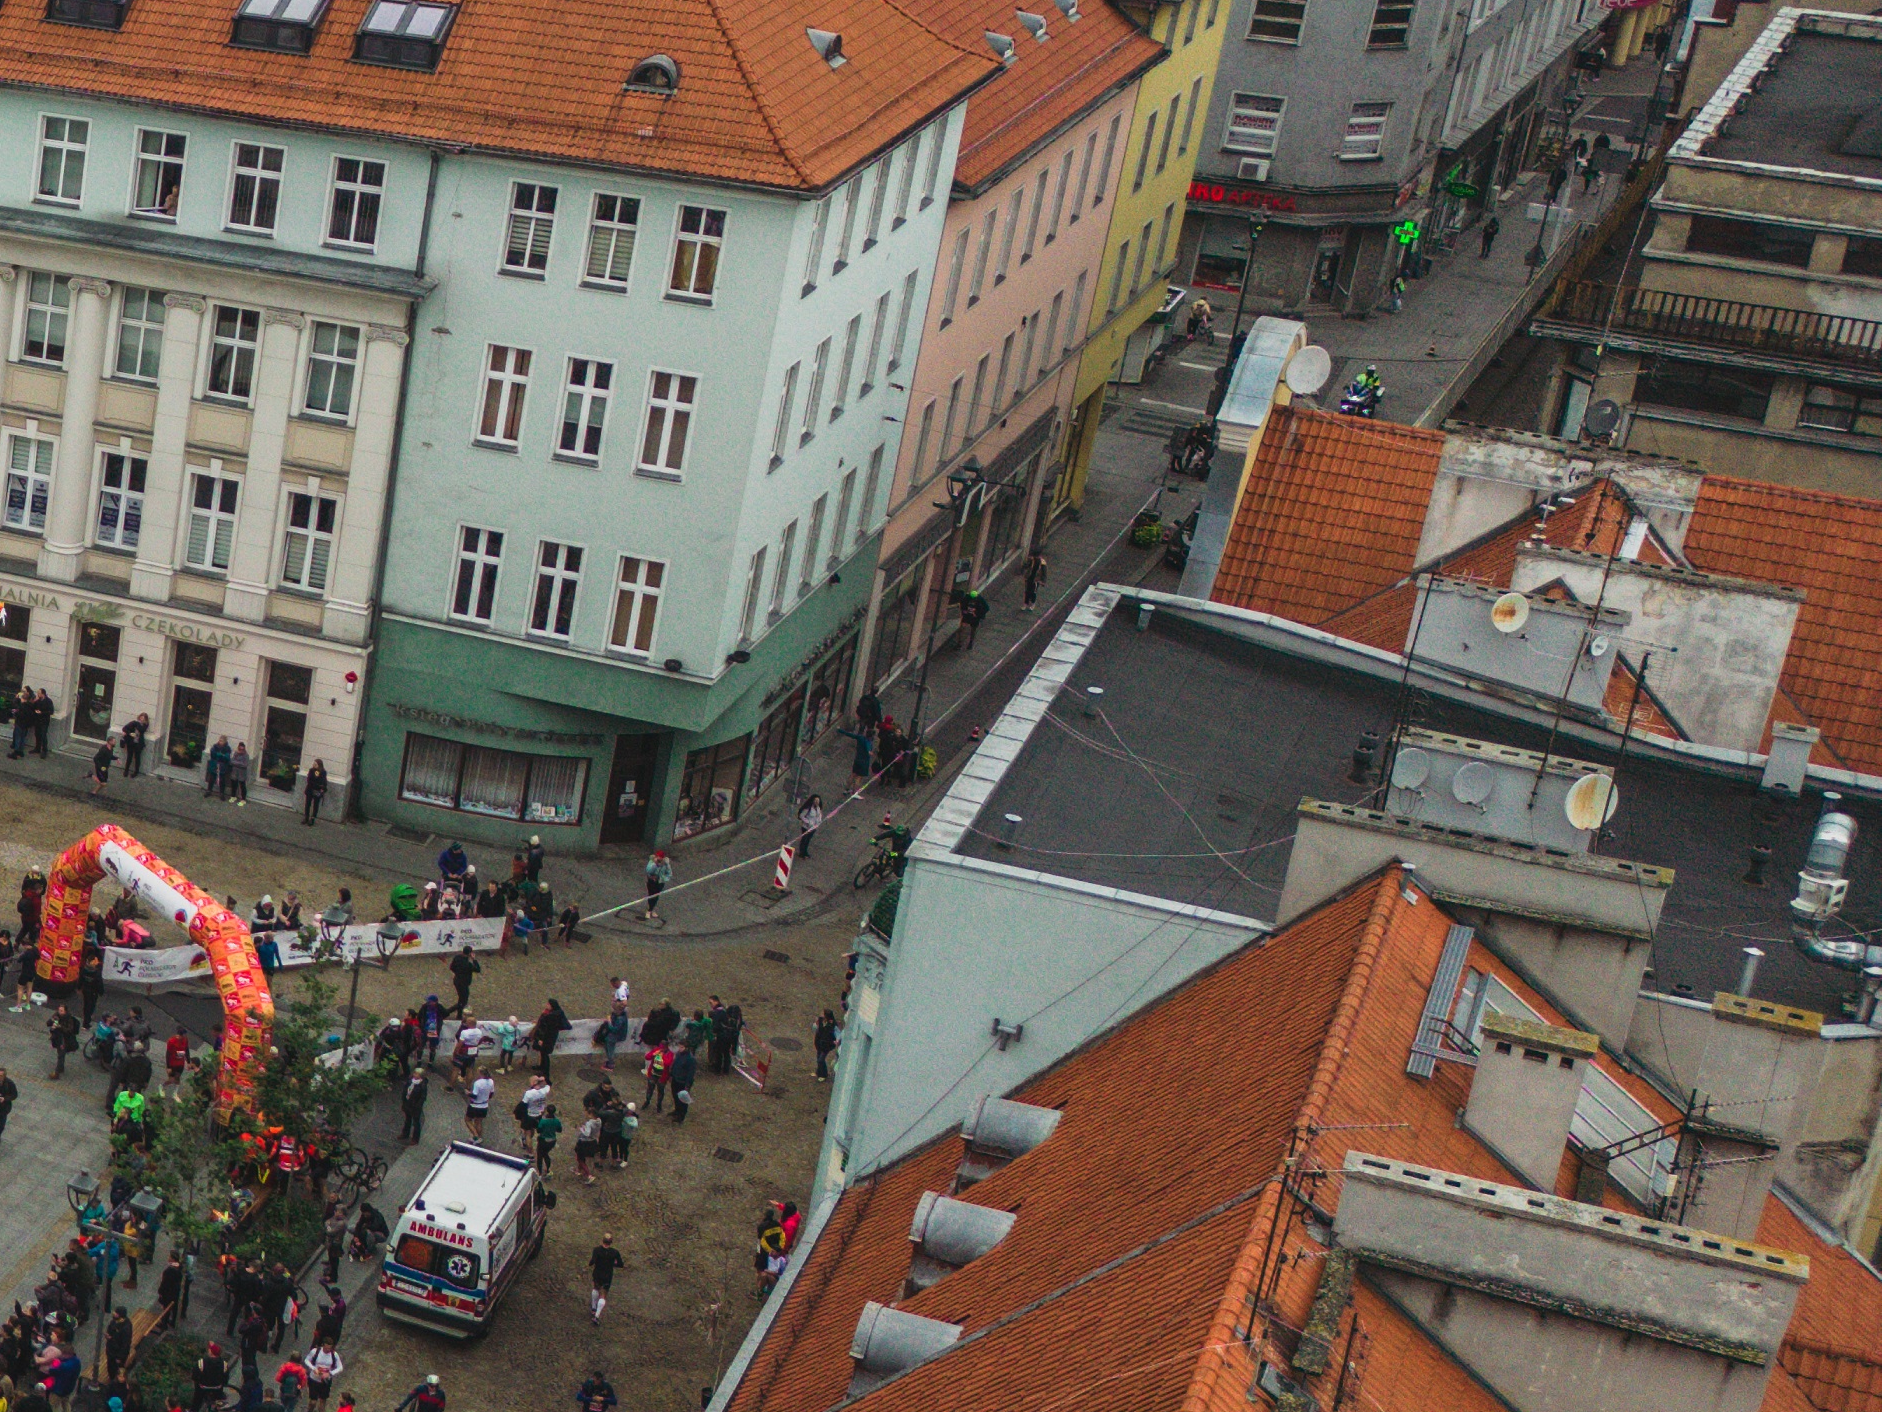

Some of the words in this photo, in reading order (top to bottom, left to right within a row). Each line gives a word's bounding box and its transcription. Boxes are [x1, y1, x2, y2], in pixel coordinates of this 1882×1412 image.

[1227, 190, 1296, 211] APTEKA
[132, 614, 246, 649] CZEKOLADY
[409, 1220, 474, 1248] AMBULANS
